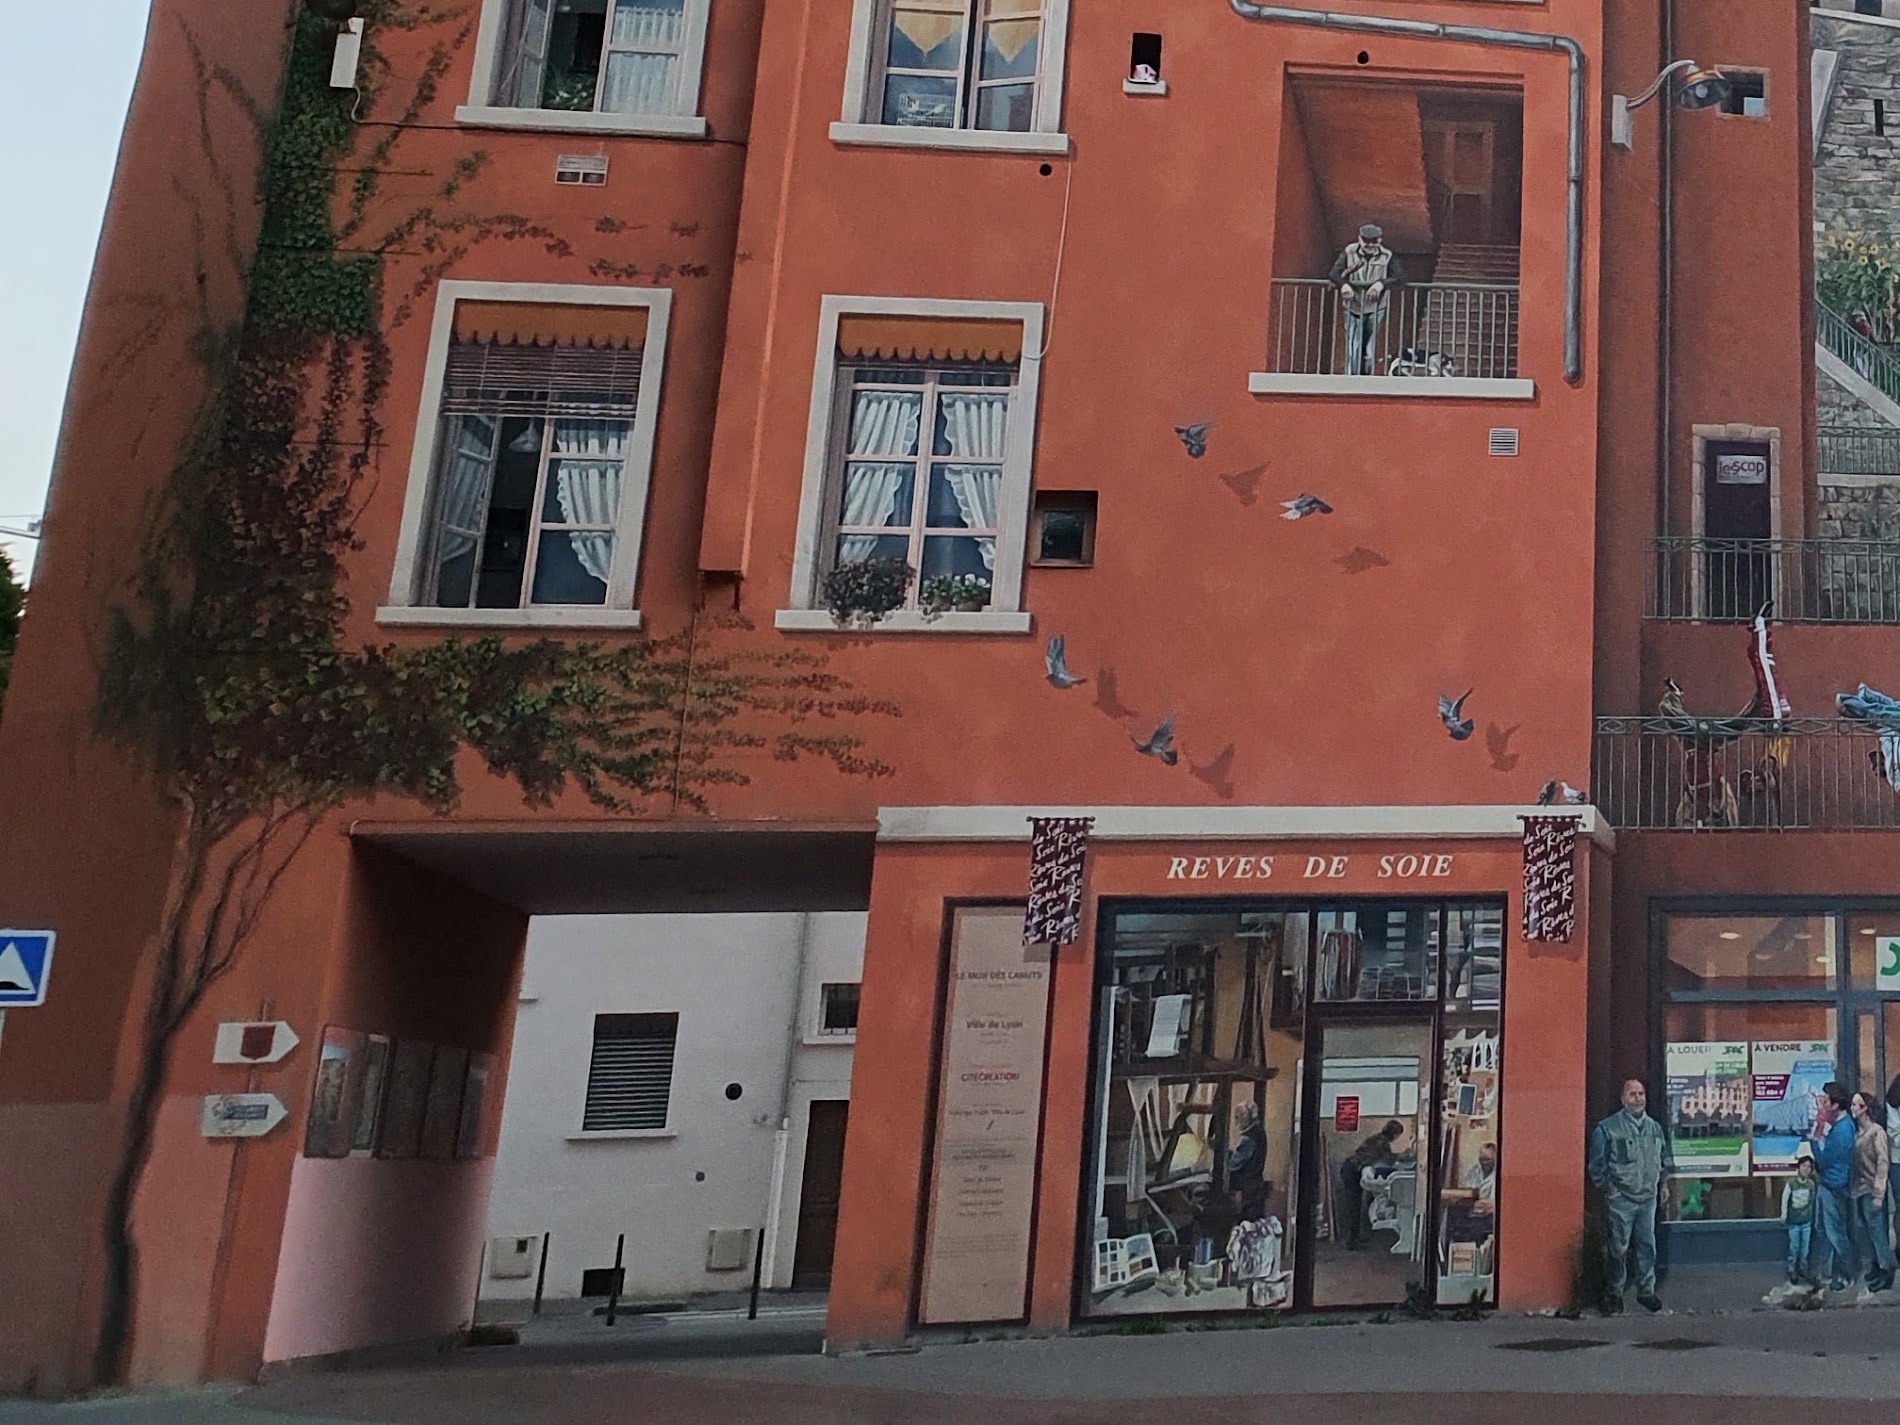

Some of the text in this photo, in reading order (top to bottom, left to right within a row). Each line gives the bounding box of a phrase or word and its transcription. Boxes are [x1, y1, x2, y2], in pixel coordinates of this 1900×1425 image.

[1167, 854, 1453, 879] REVES DE SOIE
